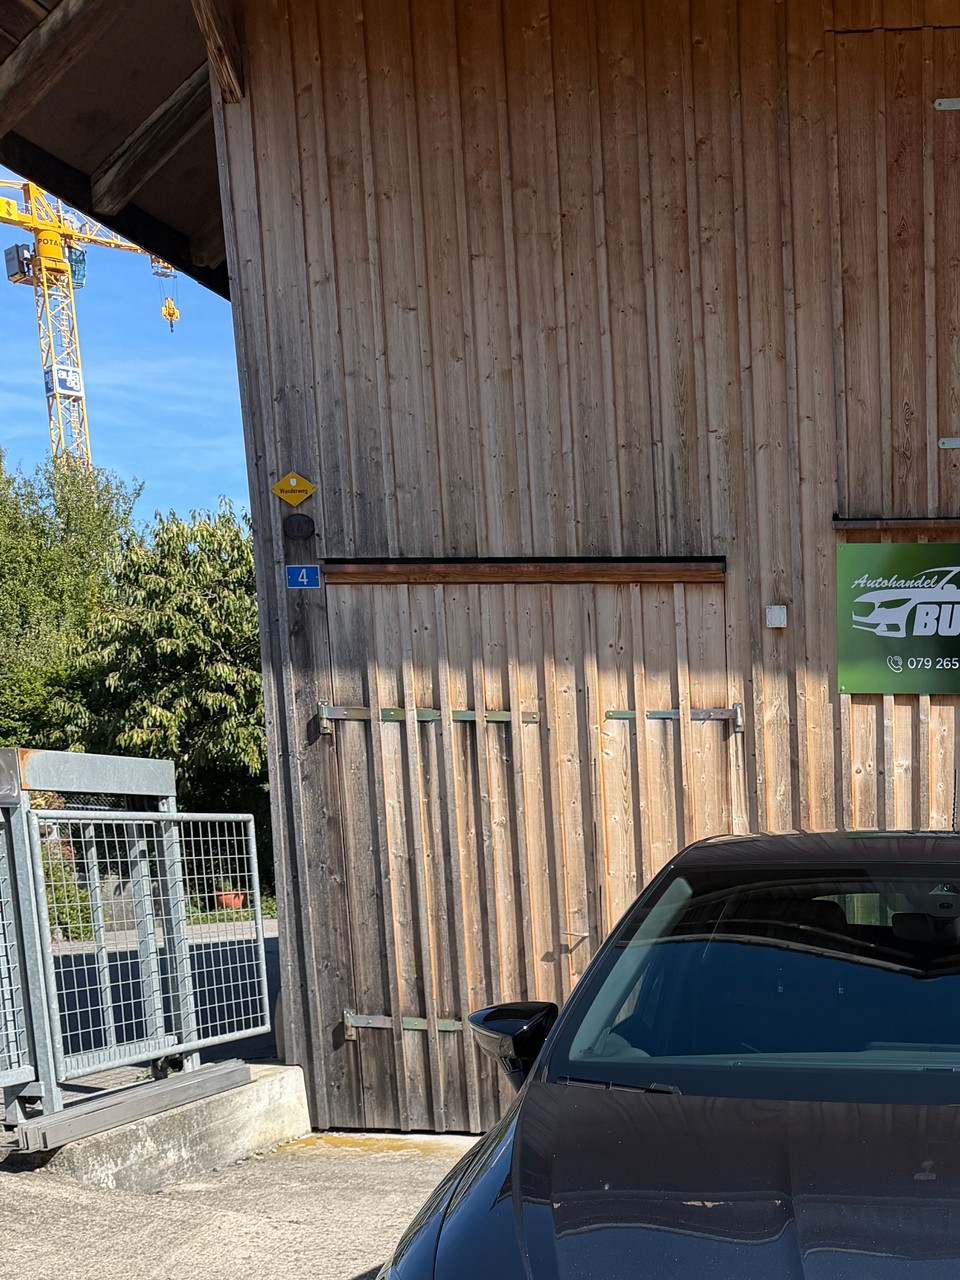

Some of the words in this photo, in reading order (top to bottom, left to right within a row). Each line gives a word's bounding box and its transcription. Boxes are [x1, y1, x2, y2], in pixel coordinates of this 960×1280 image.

[297, 568, 309, 586] 4
[851, 573, 938, 589] Autohandel
[907, 657, 932, 670] 079
[935, 657, 959, 670] 265
